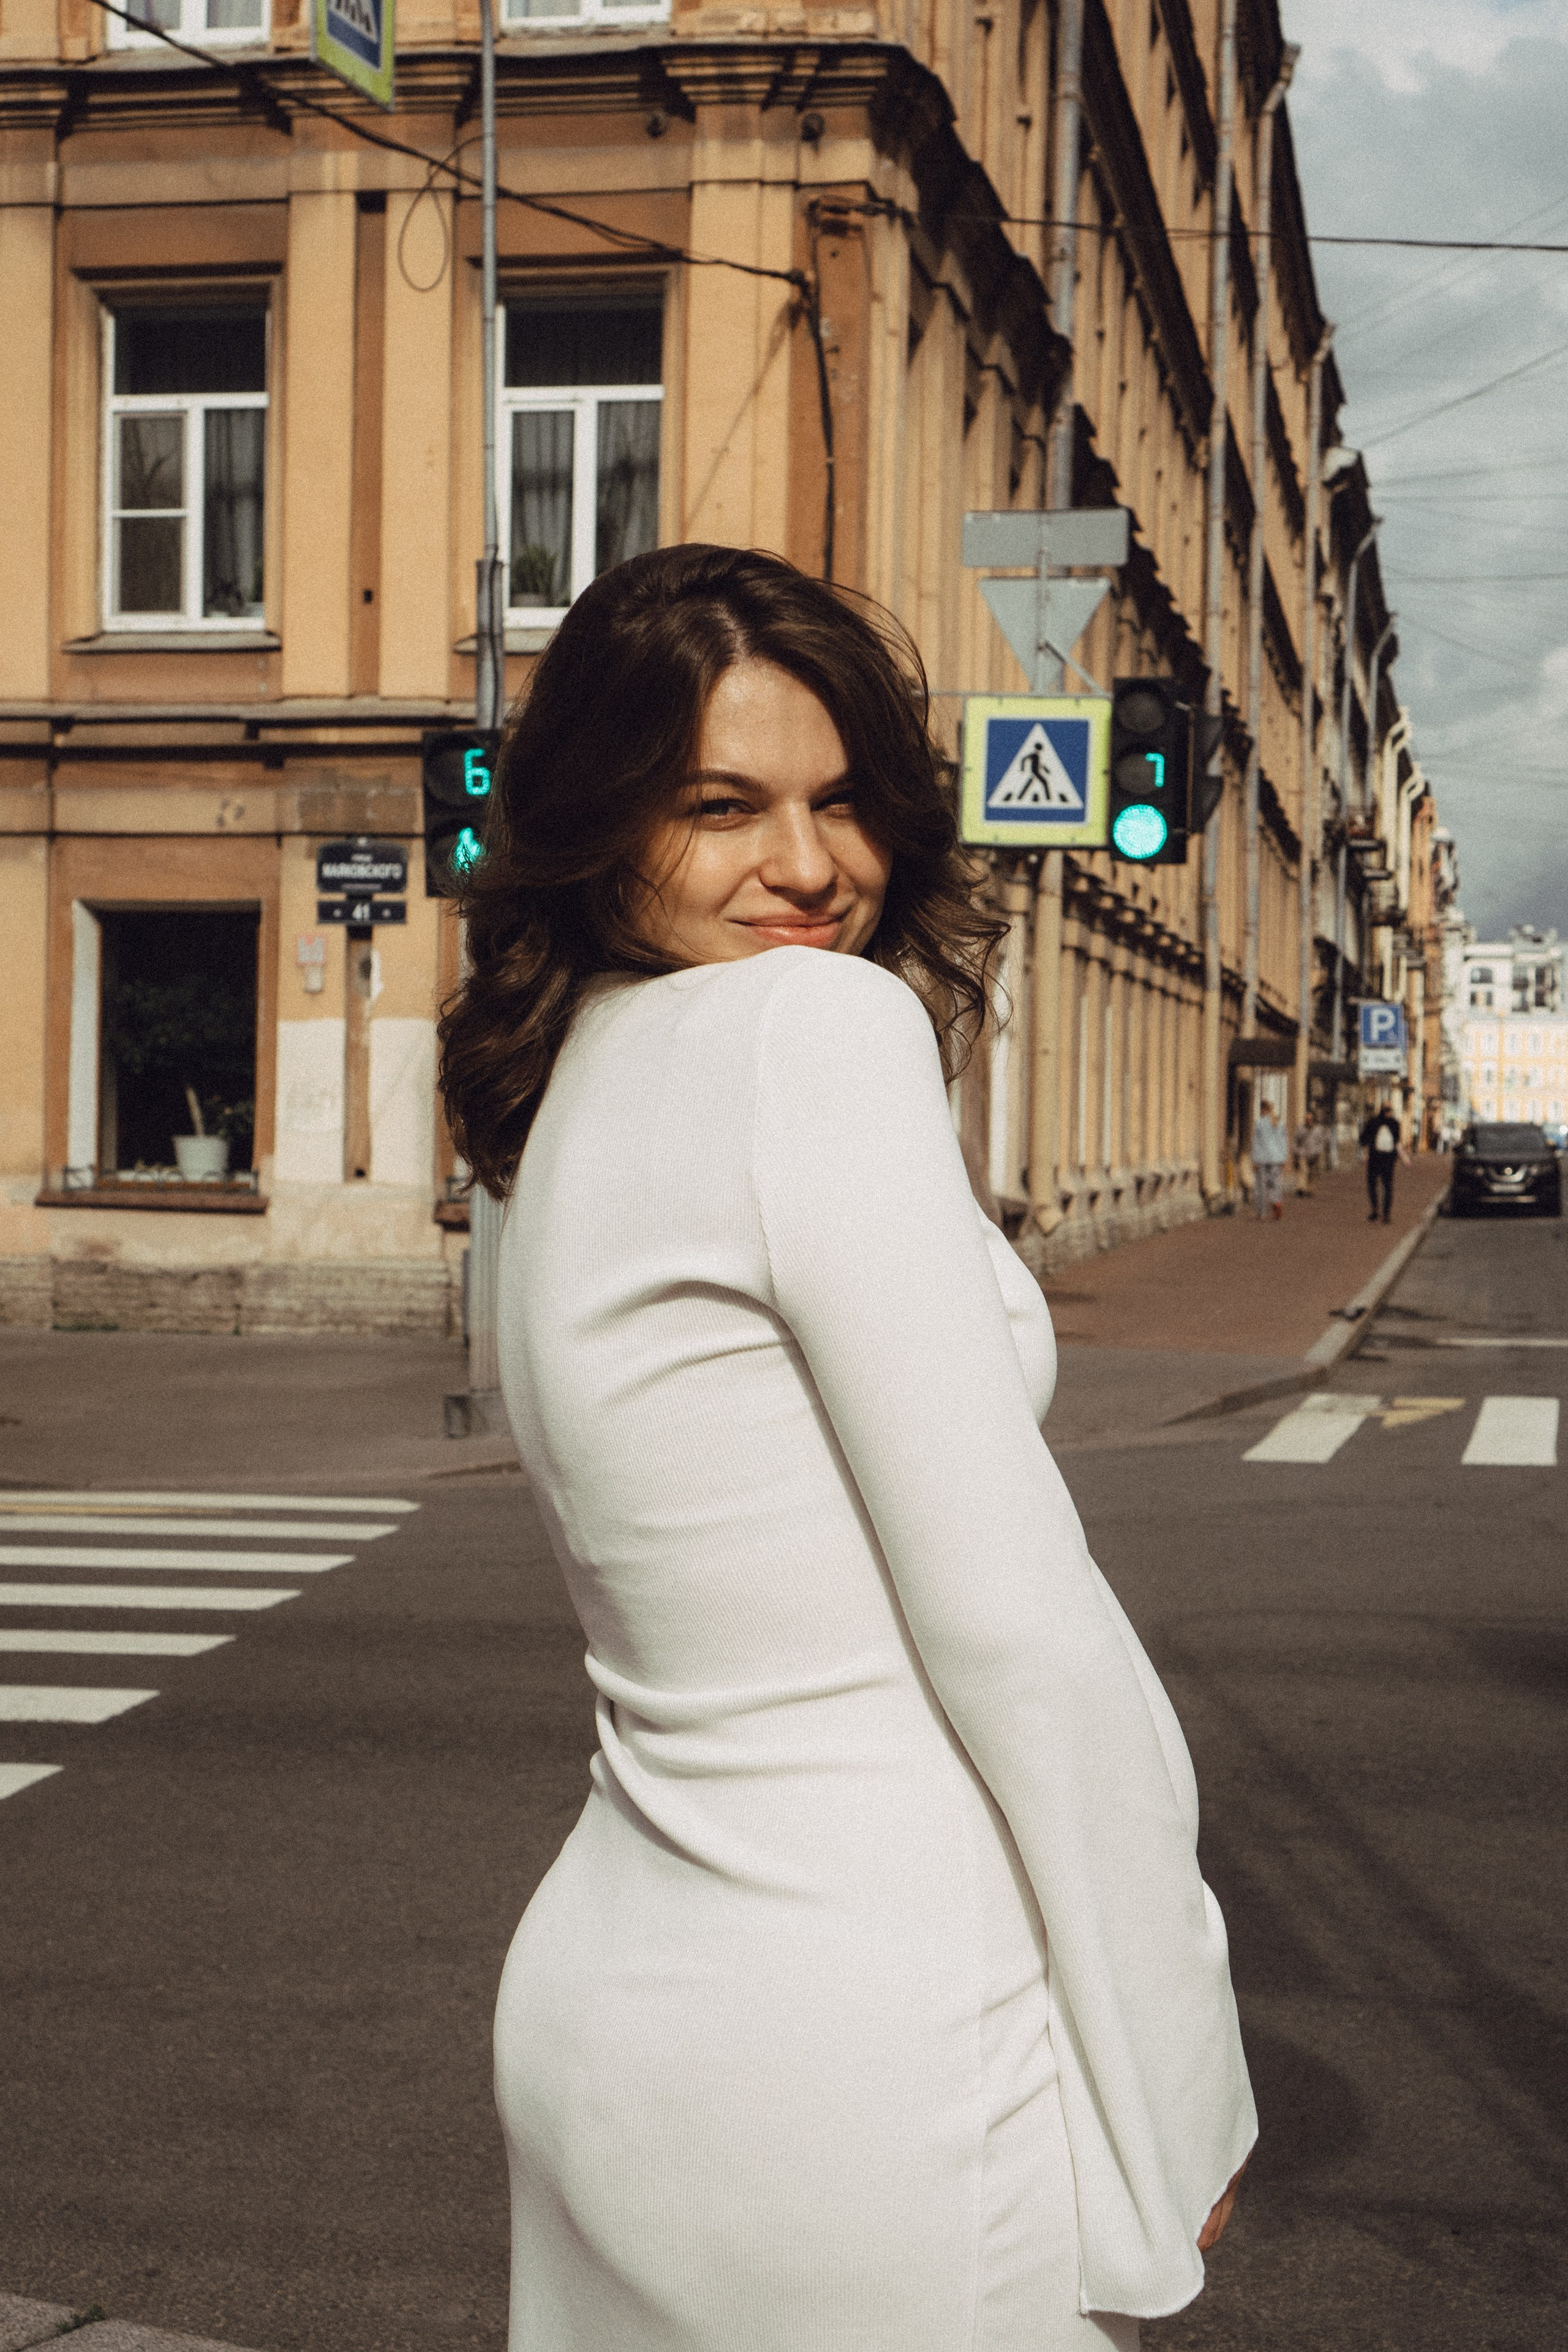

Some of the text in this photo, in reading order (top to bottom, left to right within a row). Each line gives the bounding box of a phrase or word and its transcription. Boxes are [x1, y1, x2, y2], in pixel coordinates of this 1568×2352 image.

[464, 748, 490, 795] 6
[352, 902, 371, 921] 41
[1370, 1007, 1395, 1041] P
